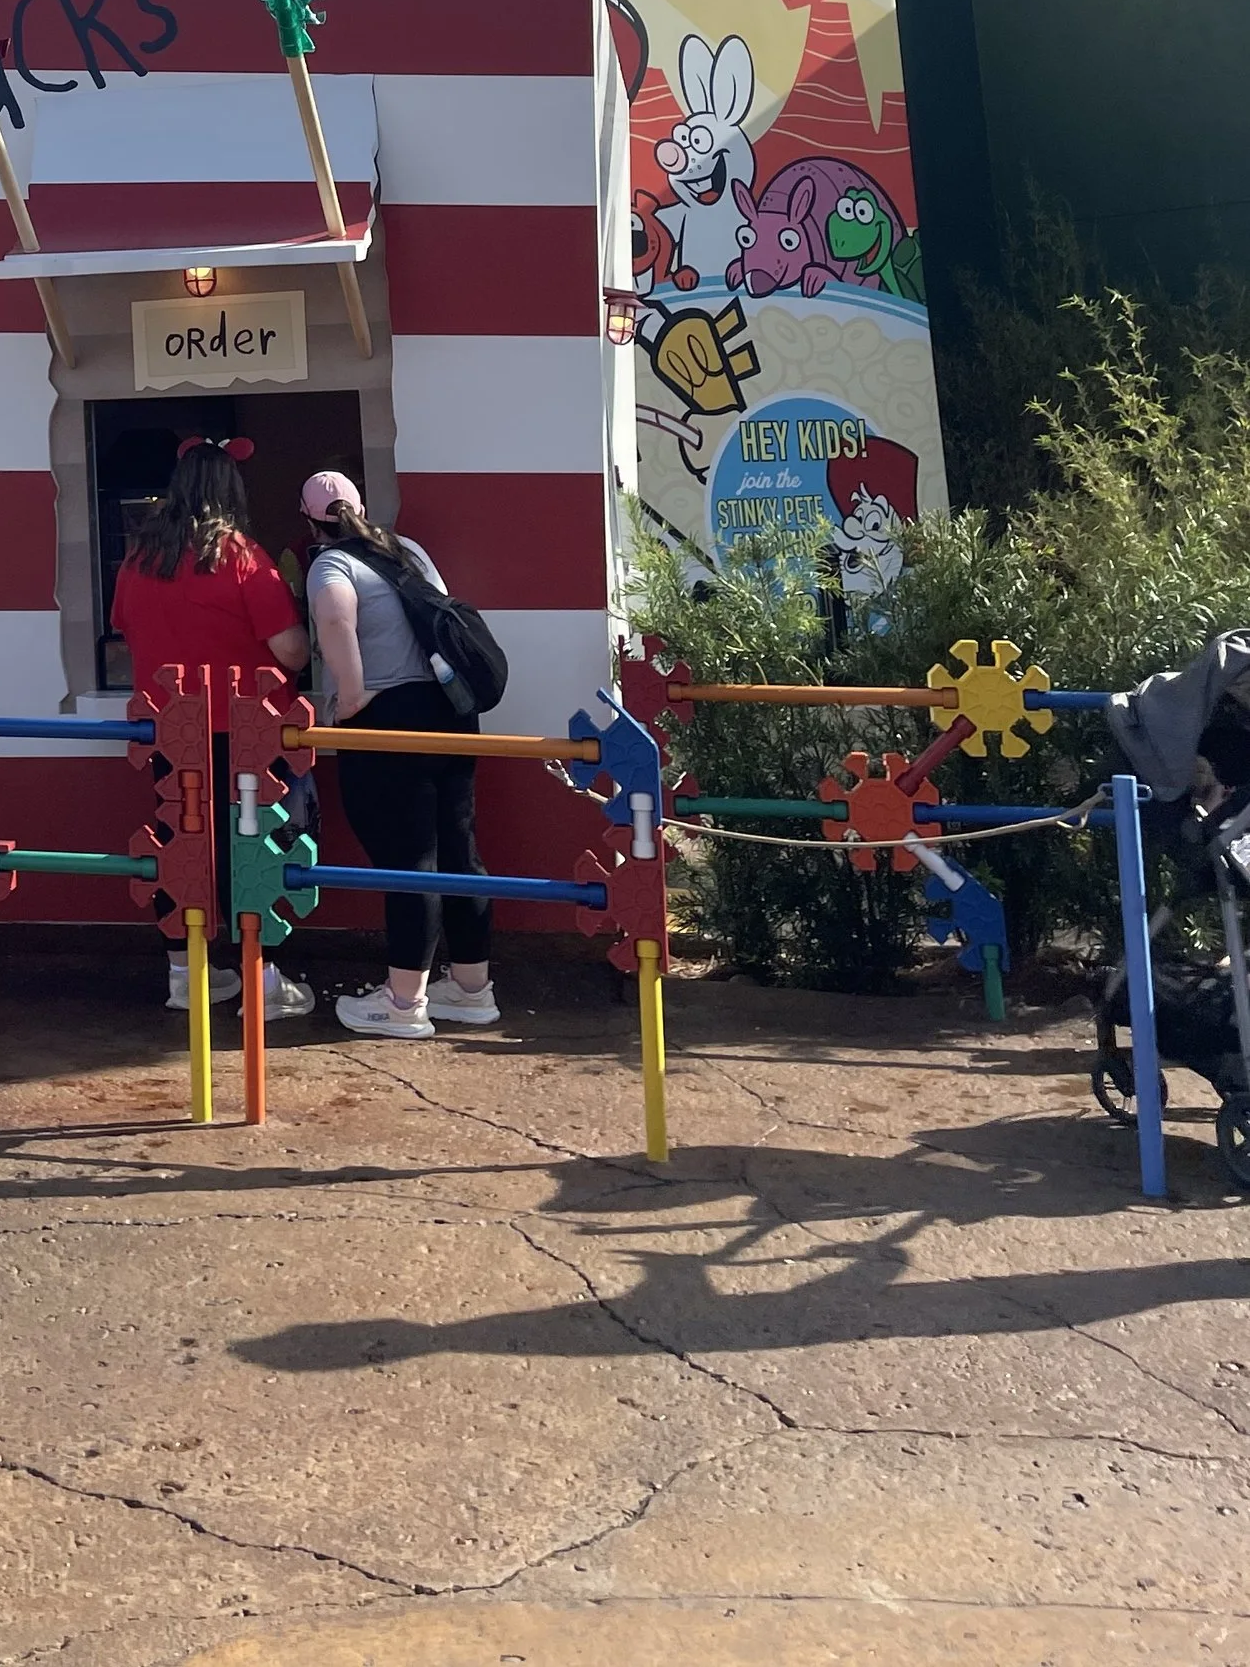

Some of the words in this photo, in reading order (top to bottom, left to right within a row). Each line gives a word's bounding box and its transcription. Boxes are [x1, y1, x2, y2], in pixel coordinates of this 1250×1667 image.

[740, 420, 789, 462] HEY
[797, 419, 868, 461] KIDS!
[736, 470, 773, 495] join
[776, 468, 802, 489] the
[717, 498, 778, 529] STINKY
